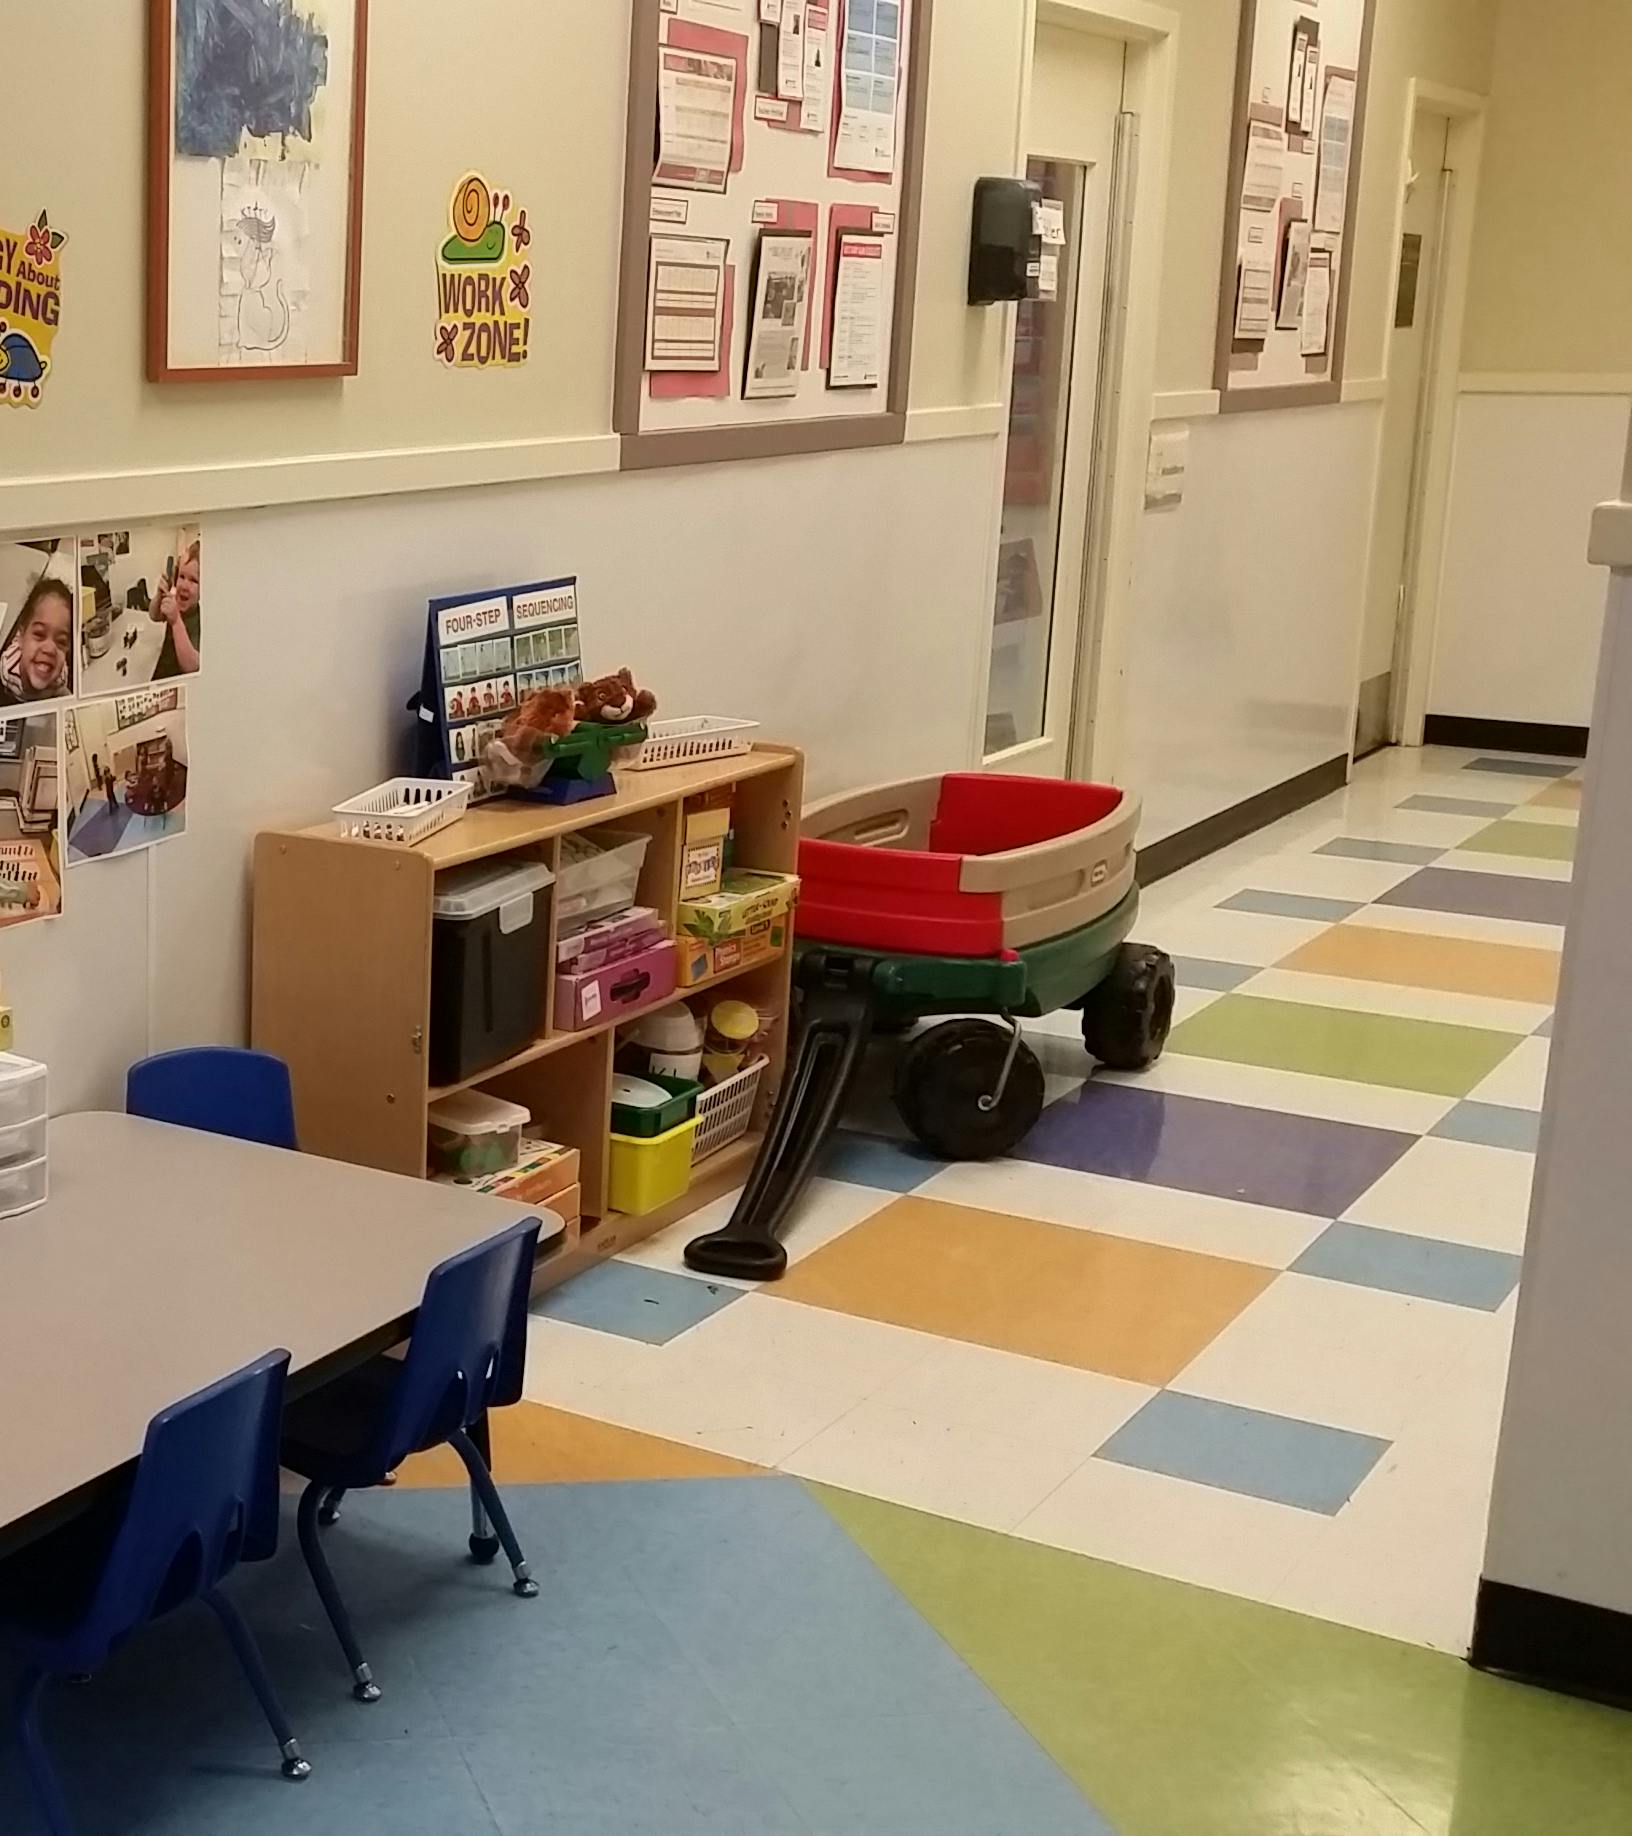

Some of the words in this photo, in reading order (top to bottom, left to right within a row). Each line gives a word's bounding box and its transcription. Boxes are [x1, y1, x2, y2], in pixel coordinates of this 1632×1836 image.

[16, 260, 60, 291] About
[442, 272, 506, 318] WORK
[461, 317, 530, 365] ZONE!
[445, 607, 502, 635] FOUR-STEP
[516, 595, 574, 619] SEQUENCING
